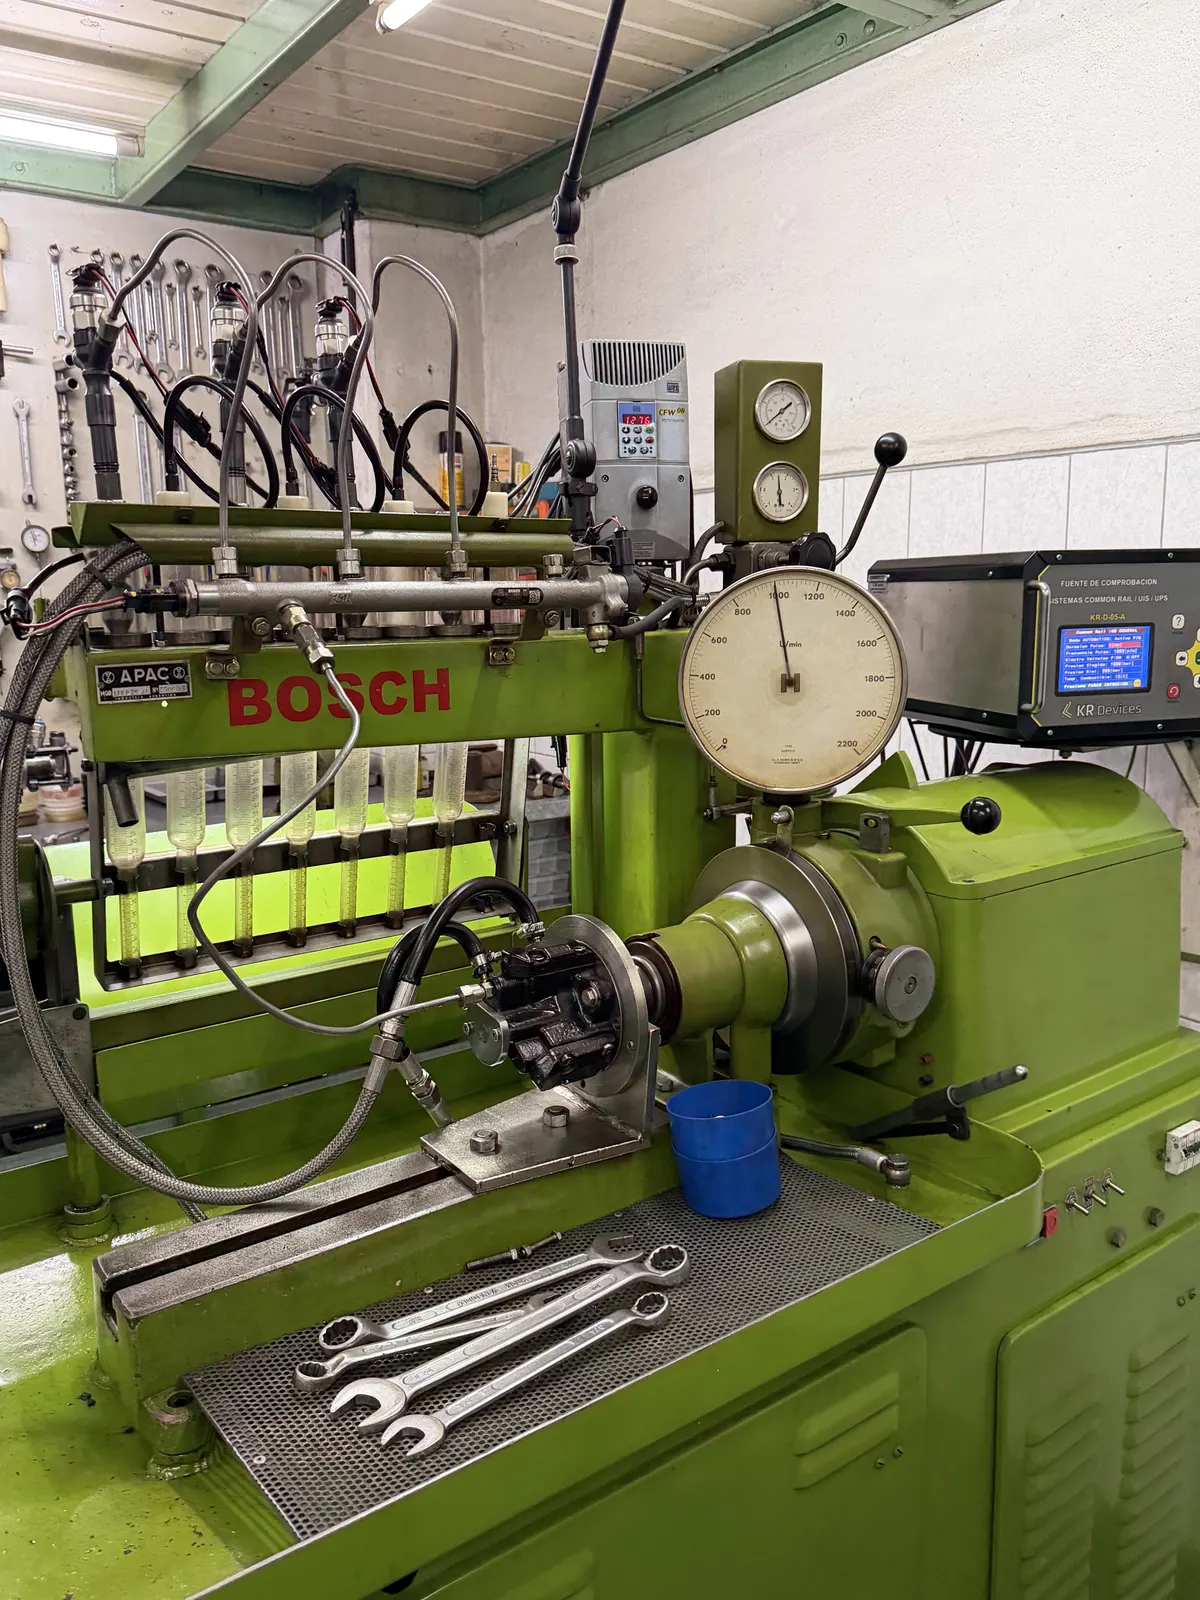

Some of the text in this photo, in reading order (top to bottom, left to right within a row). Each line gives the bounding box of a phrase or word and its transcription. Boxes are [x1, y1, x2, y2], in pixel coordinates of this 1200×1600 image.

[626, 416, 650, 424] 1276
[779, 640, 802, 648] U/min
[120, 667, 169, 683] APAC
[228, 668, 450, 726] BOSCH
[1076, 703, 1142, 717] KR Devices
